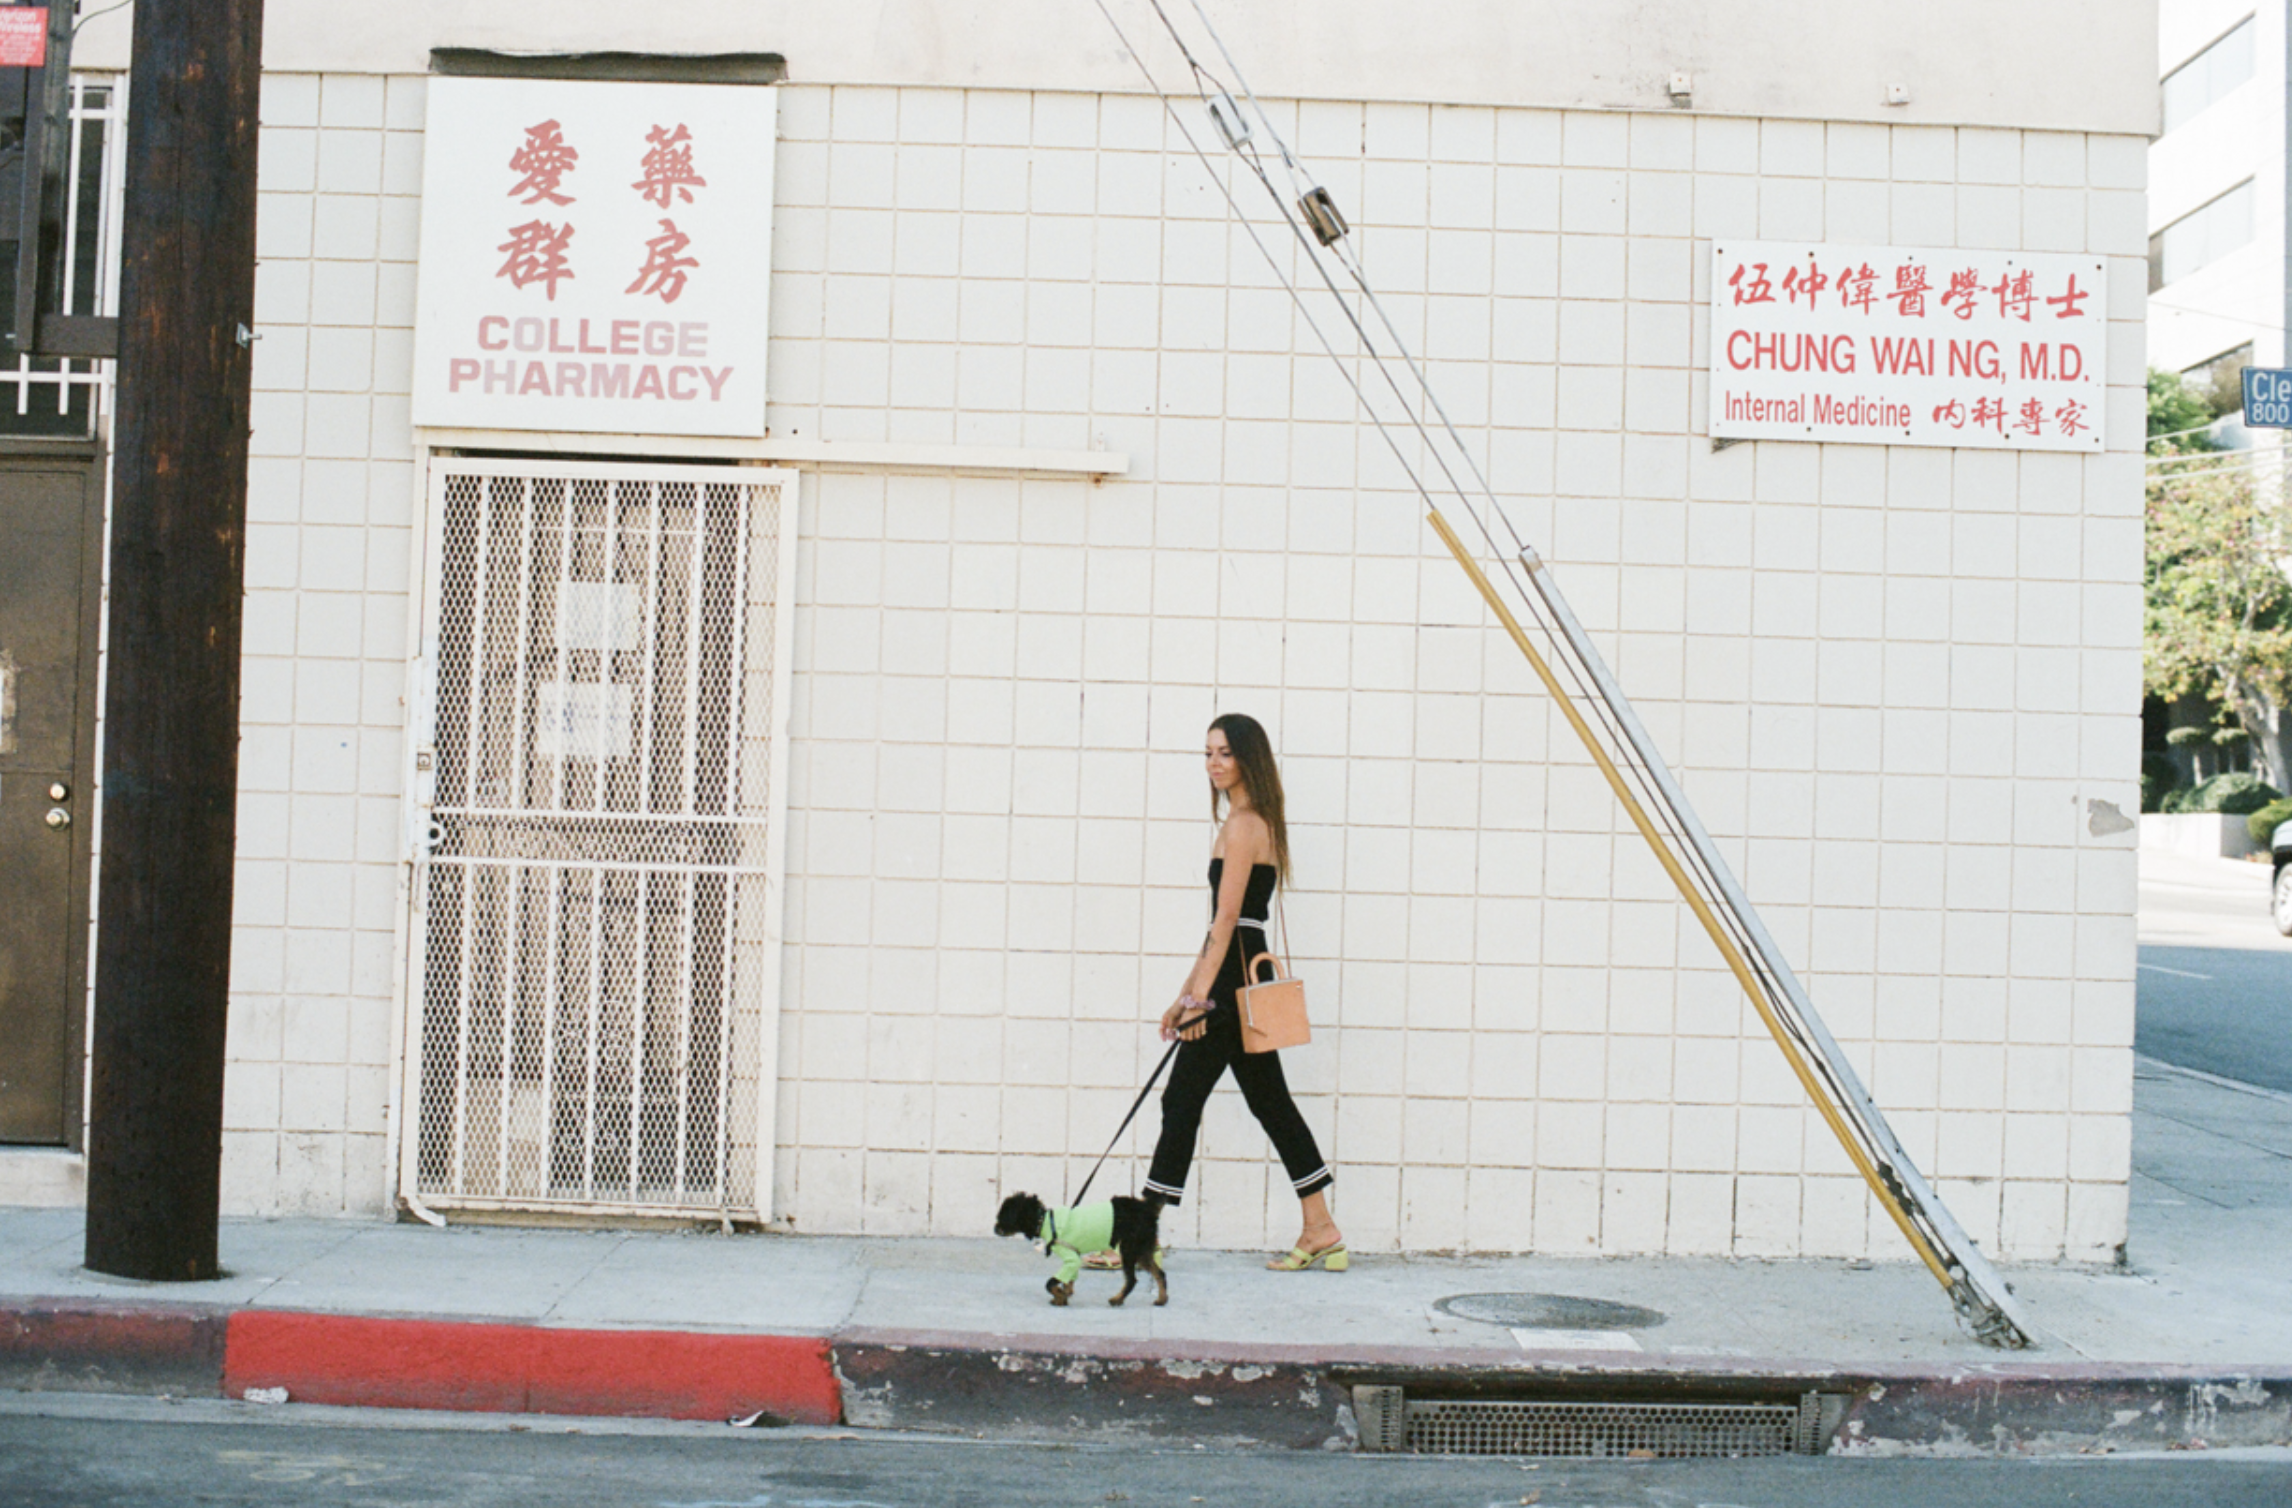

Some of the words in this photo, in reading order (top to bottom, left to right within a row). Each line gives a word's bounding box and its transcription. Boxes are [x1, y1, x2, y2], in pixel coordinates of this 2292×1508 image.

[495, 118, 579, 301] 愛群
[624, 122, 707, 304] 藥房
[1728, 261, 2089, 323] 伍仲偉醫學博士
[478, 315, 709, 357] COLLEGE
[1726, 329, 1856, 374] CHUNG
[1870, 336, 1935, 376] WAI
[1948, 339, 2006, 384] NG,
[2020, 341, 2089, 382] M.D.
[449, 357, 734, 401] PHARMACY
[1725, 390, 1805, 423] Internal
[1813, 393, 1911, 428] Medicine
[2252, 402, 2290, 423] 800
